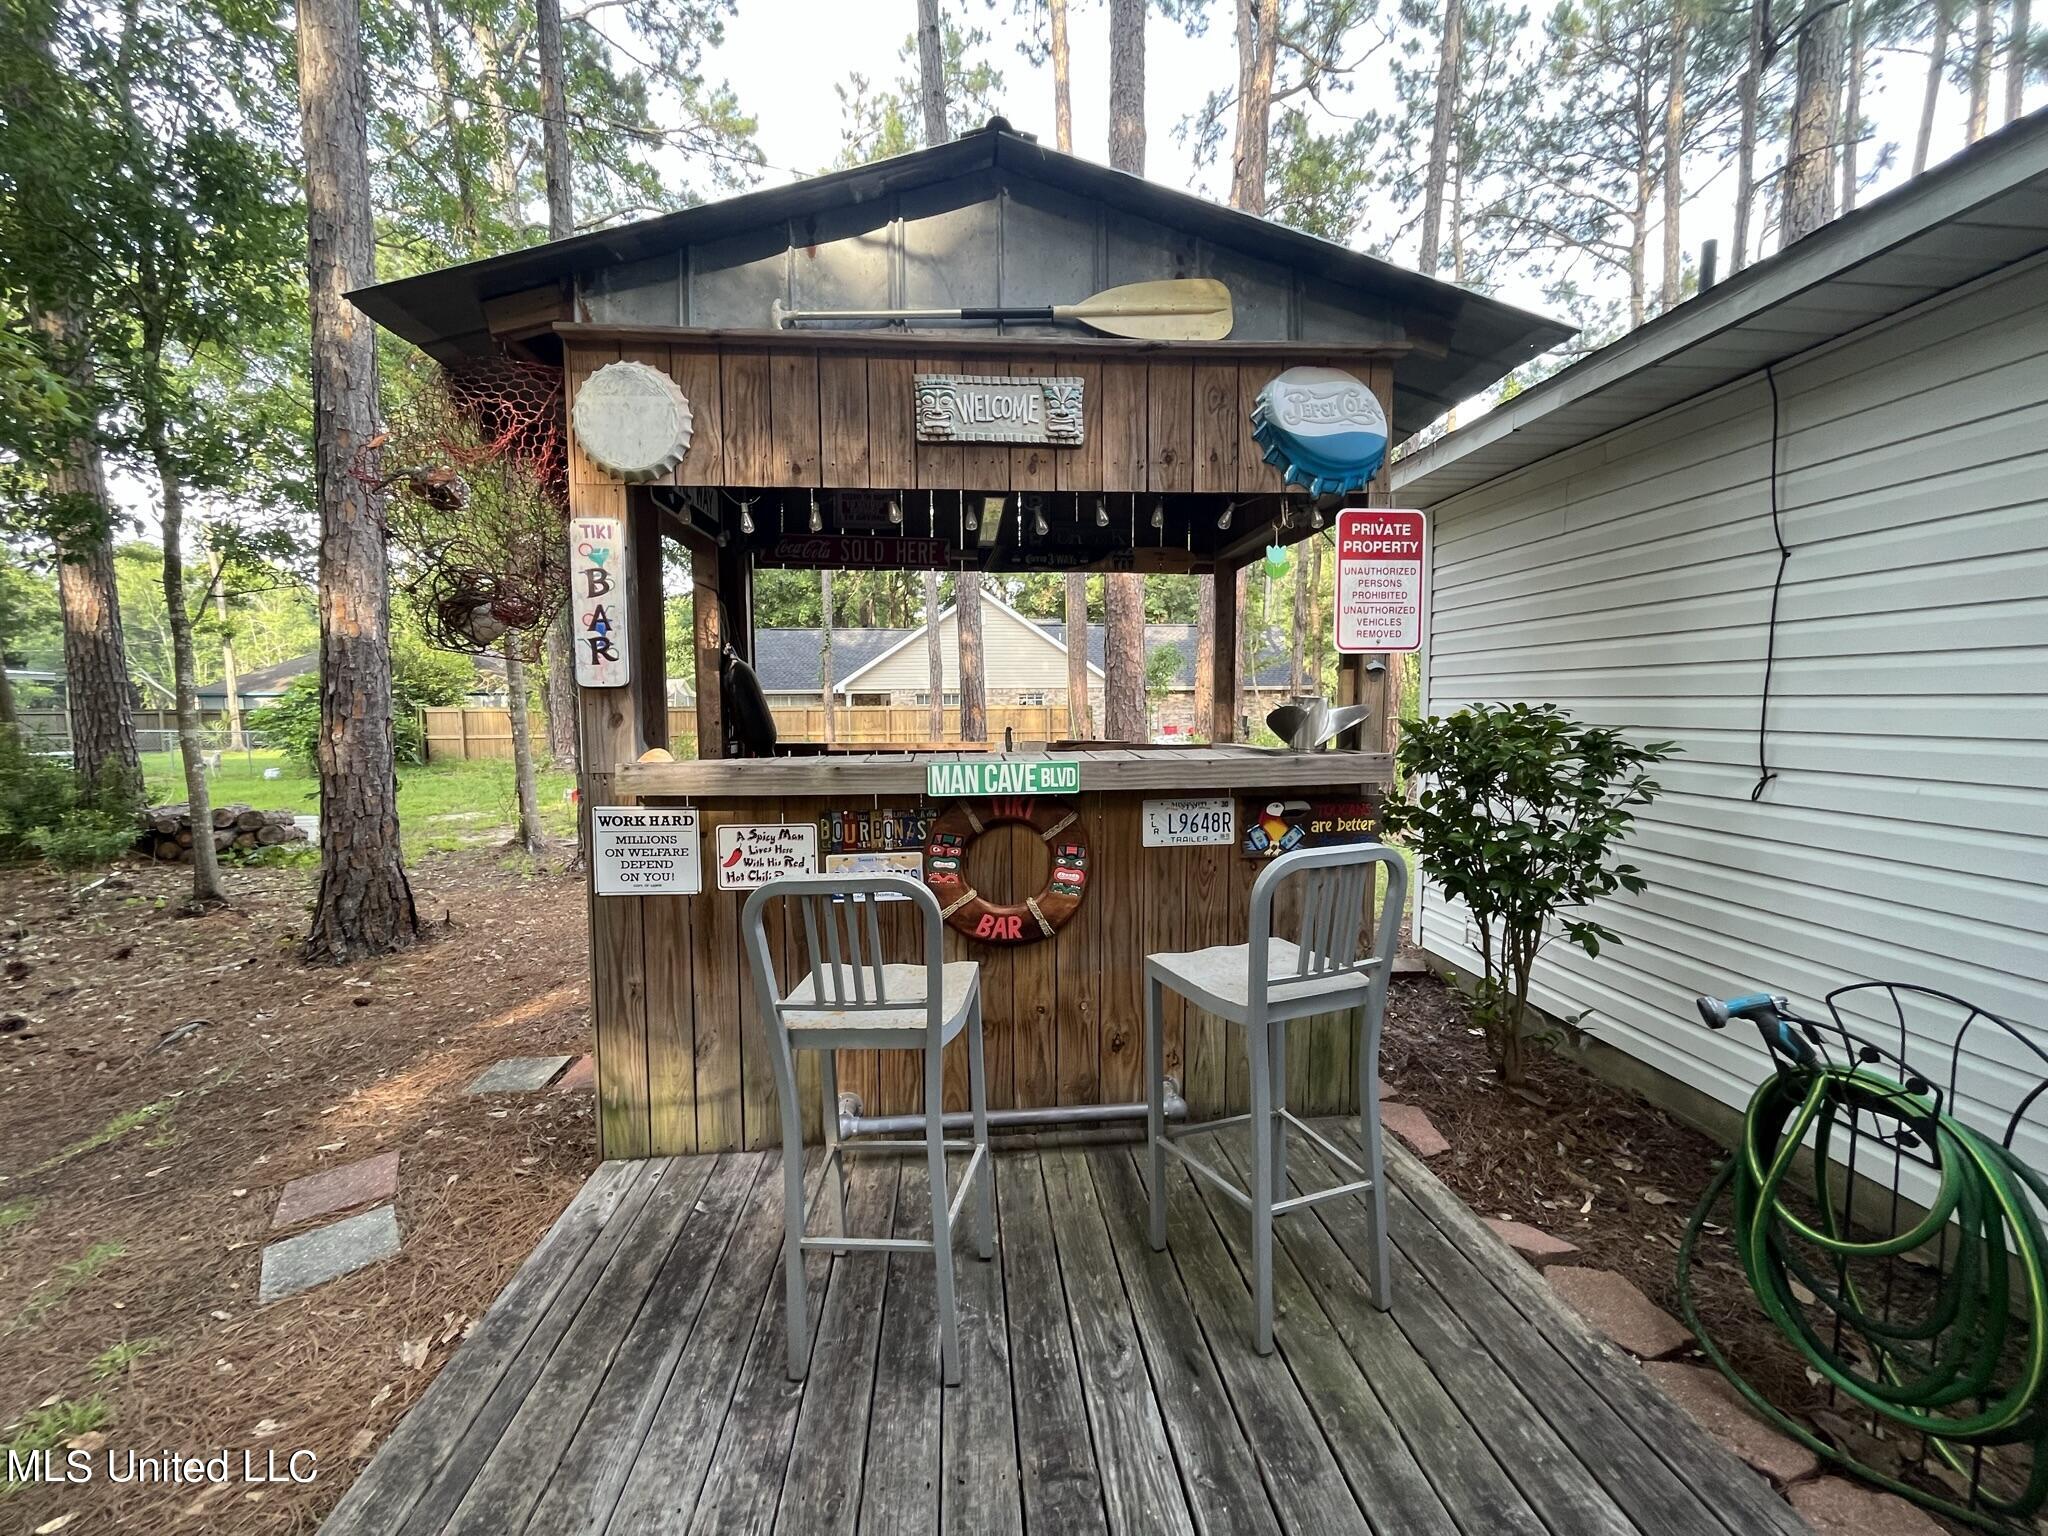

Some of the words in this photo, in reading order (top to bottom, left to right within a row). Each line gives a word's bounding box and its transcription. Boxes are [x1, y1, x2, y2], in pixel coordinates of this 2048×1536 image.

[956, 392, 1040, 425] WELCOME
[579, 524, 613, 540] TIKI
[1351, 523, 1411, 536] PRIVATE
[840, 539, 884, 563] SOLD
[896, 541, 939, 565] HERE
[1343, 541, 1419, 553] PROPERTY
[1344, 567, 1417, 576] UNAUTHORIZED
[1358, 579, 1403, 588] PERSONS
[1352, 591, 1408, 600] PROHIBITED
[585, 567, 620, 666] BAR
[1343, 606, 1416, 615] UNAUTHORIZED
[1357, 618, 1402, 627] VEHICLES
[1356, 629, 1402, 638] REMOVED
[932, 765, 979, 794] MAN
[984, 763, 1038, 793] CAVE
[1041, 767, 1076, 788] BLVD
[597, 815, 647, 827] WORK
[649, 815, 695, 827] HARD
[1168, 811, 1232, 835] L9648R
[1311, 820, 1333, 833] are
[1337, 817, 1377, 832] better
[616, 835, 678, 845] MILLIONS
[736, 830, 746, 842] A
[747, 828, 776, 845] Spicy
[778, 828, 804, 841] Man
[1170, 835, 1209, 844] TRAILER
[605, 848, 625, 858] ON
[628, 847, 689, 857] WELFARE
[748, 844, 772, 855] Lives
[774, 844, 794, 854] Here
[621, 860, 674, 869] DEPEND
[743, 857, 765, 868] With
[767, 857, 782, 868] His
[783, 855, 806, 868] Red
[620, 873, 640, 882] ON
[643, 872, 676, 882] YOU!
[726, 870, 745, 883] Hot
[748, 869, 772, 883] Chili
[974, 913, 1023, 940] BAR
